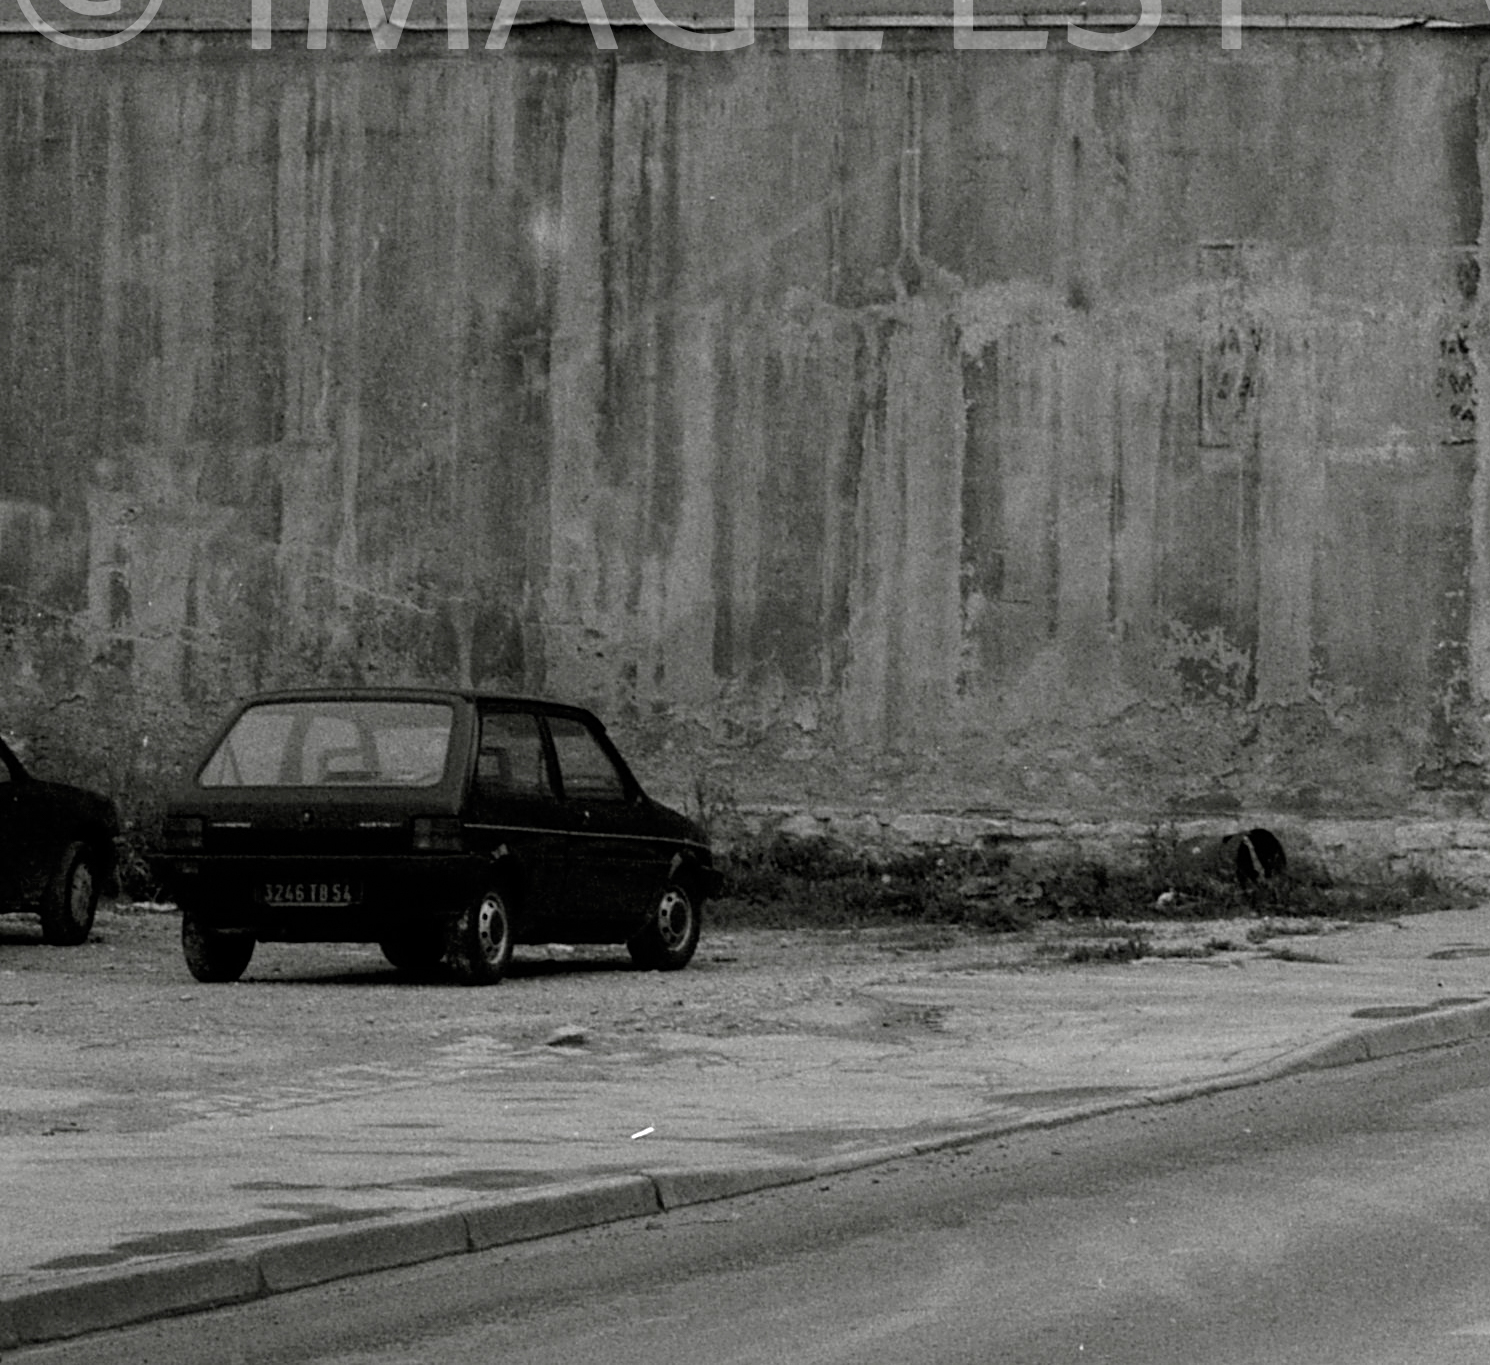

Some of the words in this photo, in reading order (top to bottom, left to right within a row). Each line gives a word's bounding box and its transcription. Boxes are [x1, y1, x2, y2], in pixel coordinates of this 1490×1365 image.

[264, 883, 305, 902] 3246
[310, 883, 329, 902] TB
[332, 883, 352, 902] 54
